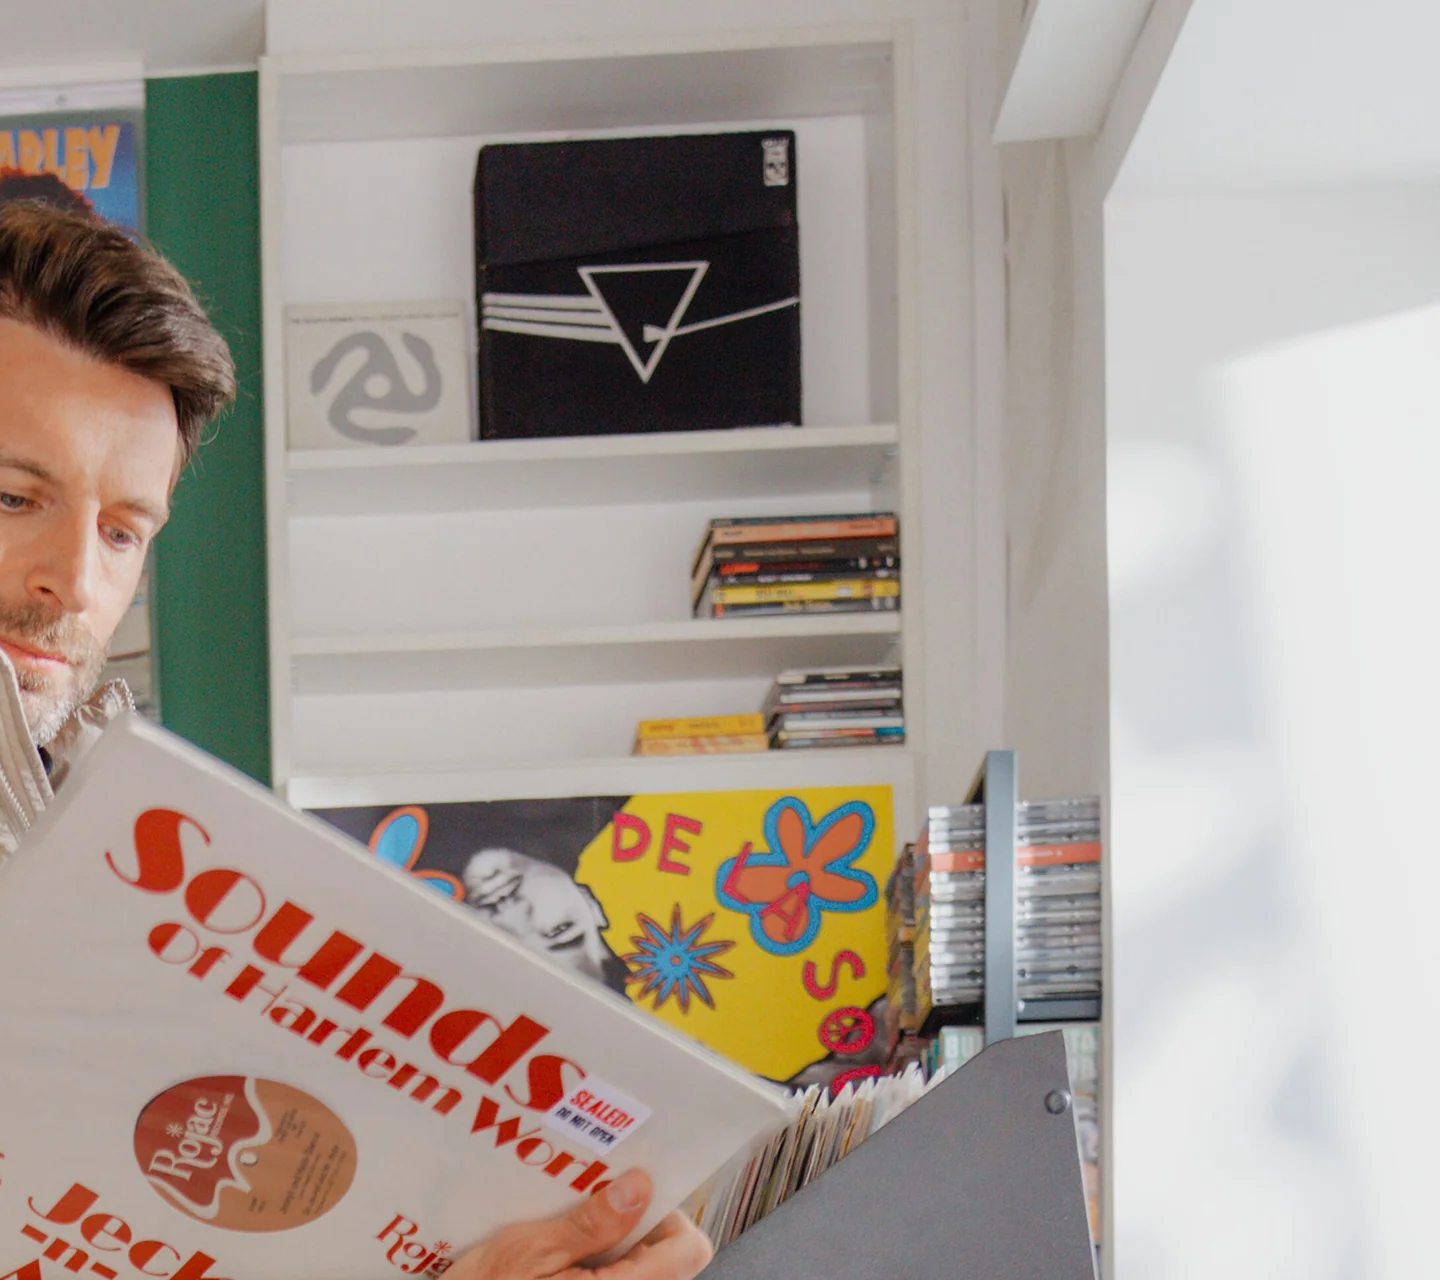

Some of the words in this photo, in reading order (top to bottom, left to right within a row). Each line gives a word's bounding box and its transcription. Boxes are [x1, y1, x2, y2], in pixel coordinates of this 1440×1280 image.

[612, 810, 703, 875] DE
[723, 841, 810, 941] LA
[105, 808, 586, 1114] Sounds
[147, 921, 232, 978] Of
[224, 961, 463, 1117] Harlem
[148, 1096, 224, 1181] Rojac
[556, 1107, 572, 1121] DO
[570, 1115, 592, 1131] NOT
[589, 1127, 616, 1145] OPEN
[570, 1090, 635, 1132] SEALED!
[375, 1213, 454, 1276] Roja
